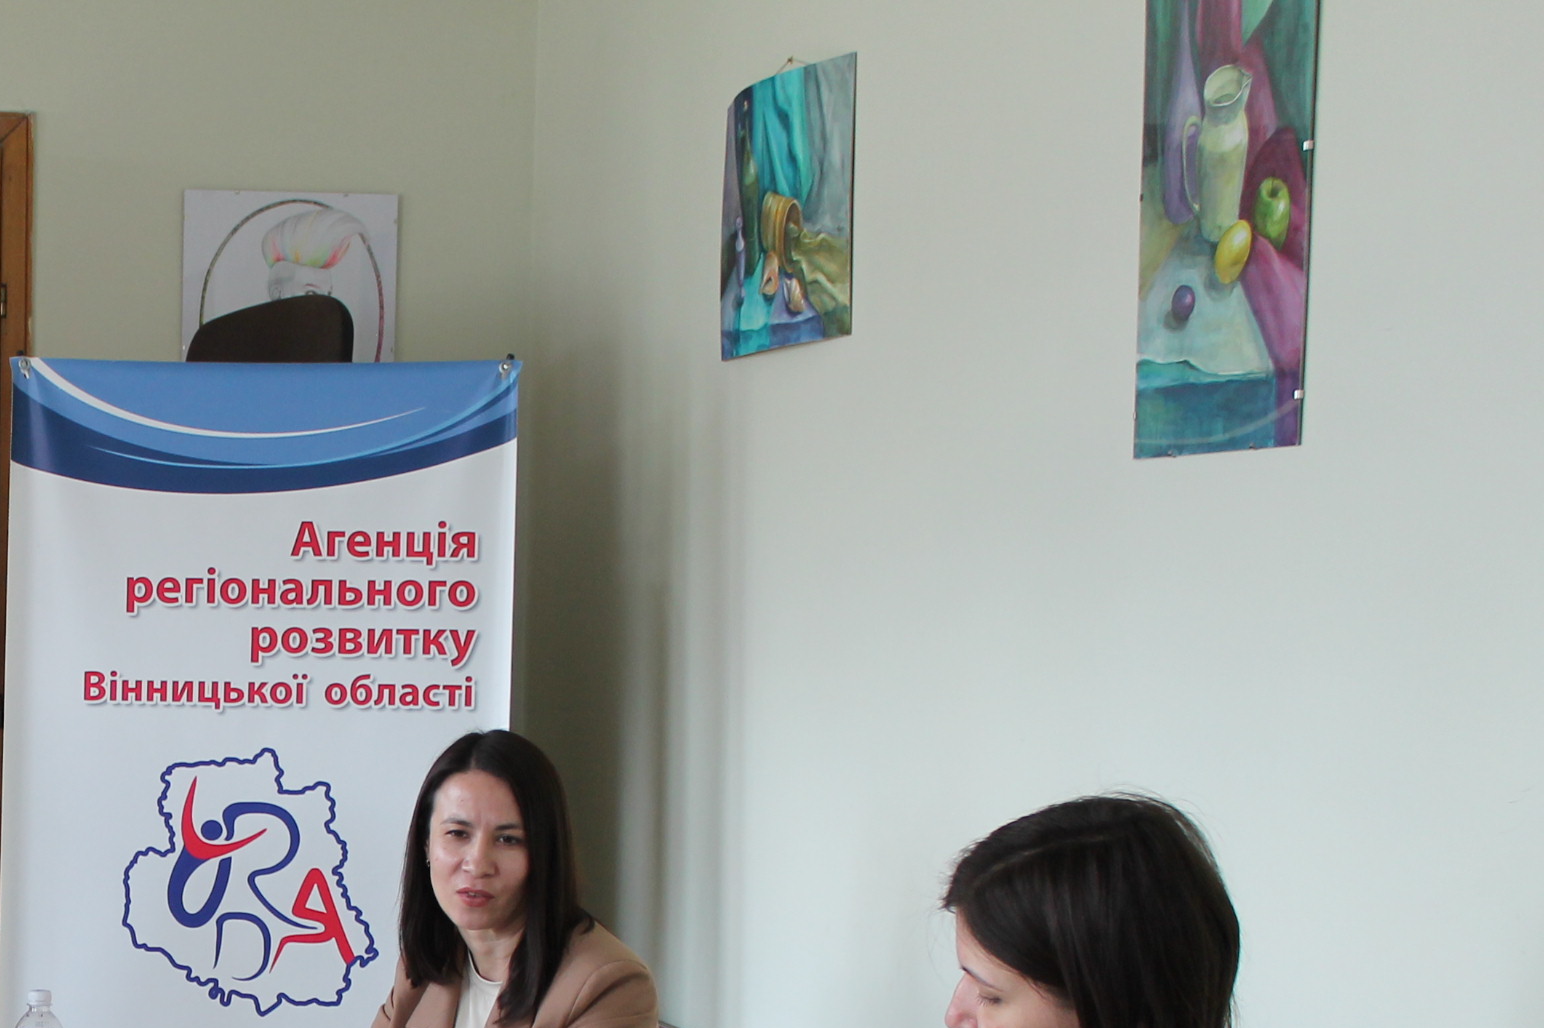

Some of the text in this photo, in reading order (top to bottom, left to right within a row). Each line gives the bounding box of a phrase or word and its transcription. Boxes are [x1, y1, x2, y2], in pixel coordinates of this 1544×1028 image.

[290, 521, 477, 566] Агенція
[125, 567, 477, 613] регіонального
[249, 626, 477, 665] розвитку
[83, 671, 475, 711] Вінницької області
